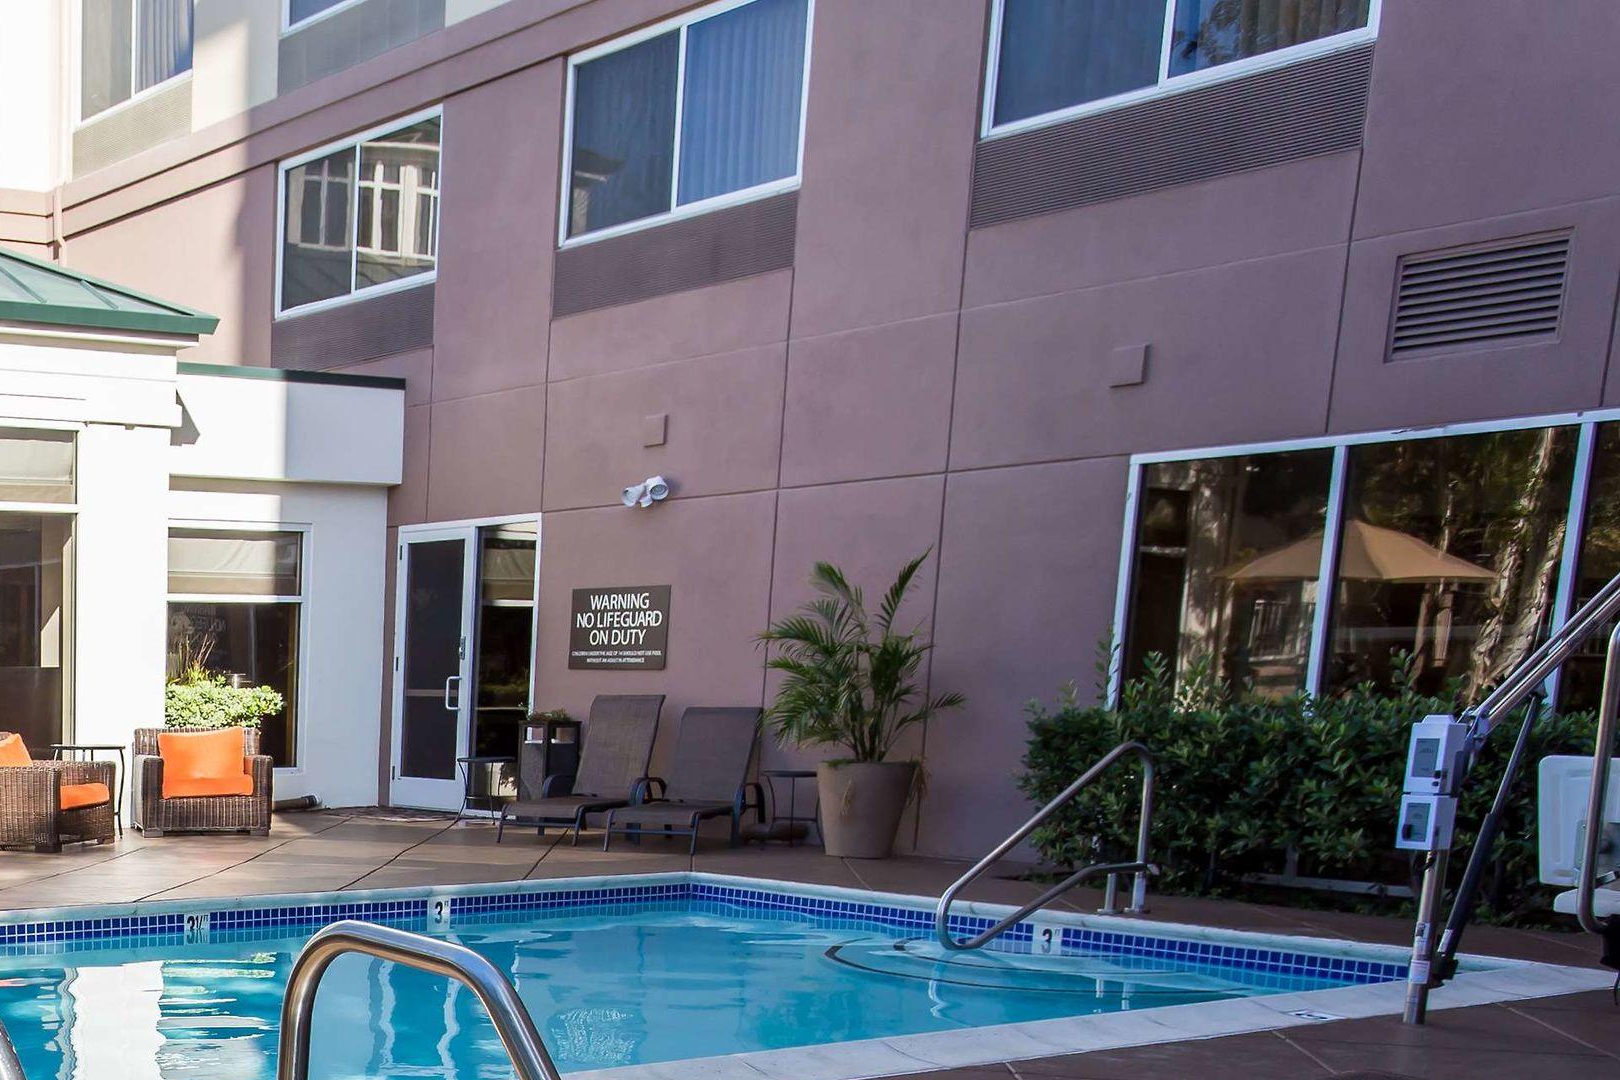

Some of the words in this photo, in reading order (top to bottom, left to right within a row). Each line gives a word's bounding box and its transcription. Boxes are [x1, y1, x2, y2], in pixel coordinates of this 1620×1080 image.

[590, 592, 650, 610] WARNING
[576, 612, 595, 628] NO
[597, 610, 663, 628] LIFEGUARD
[589, 629, 609, 645] ON
[611, 628, 647, 645] DUTY
